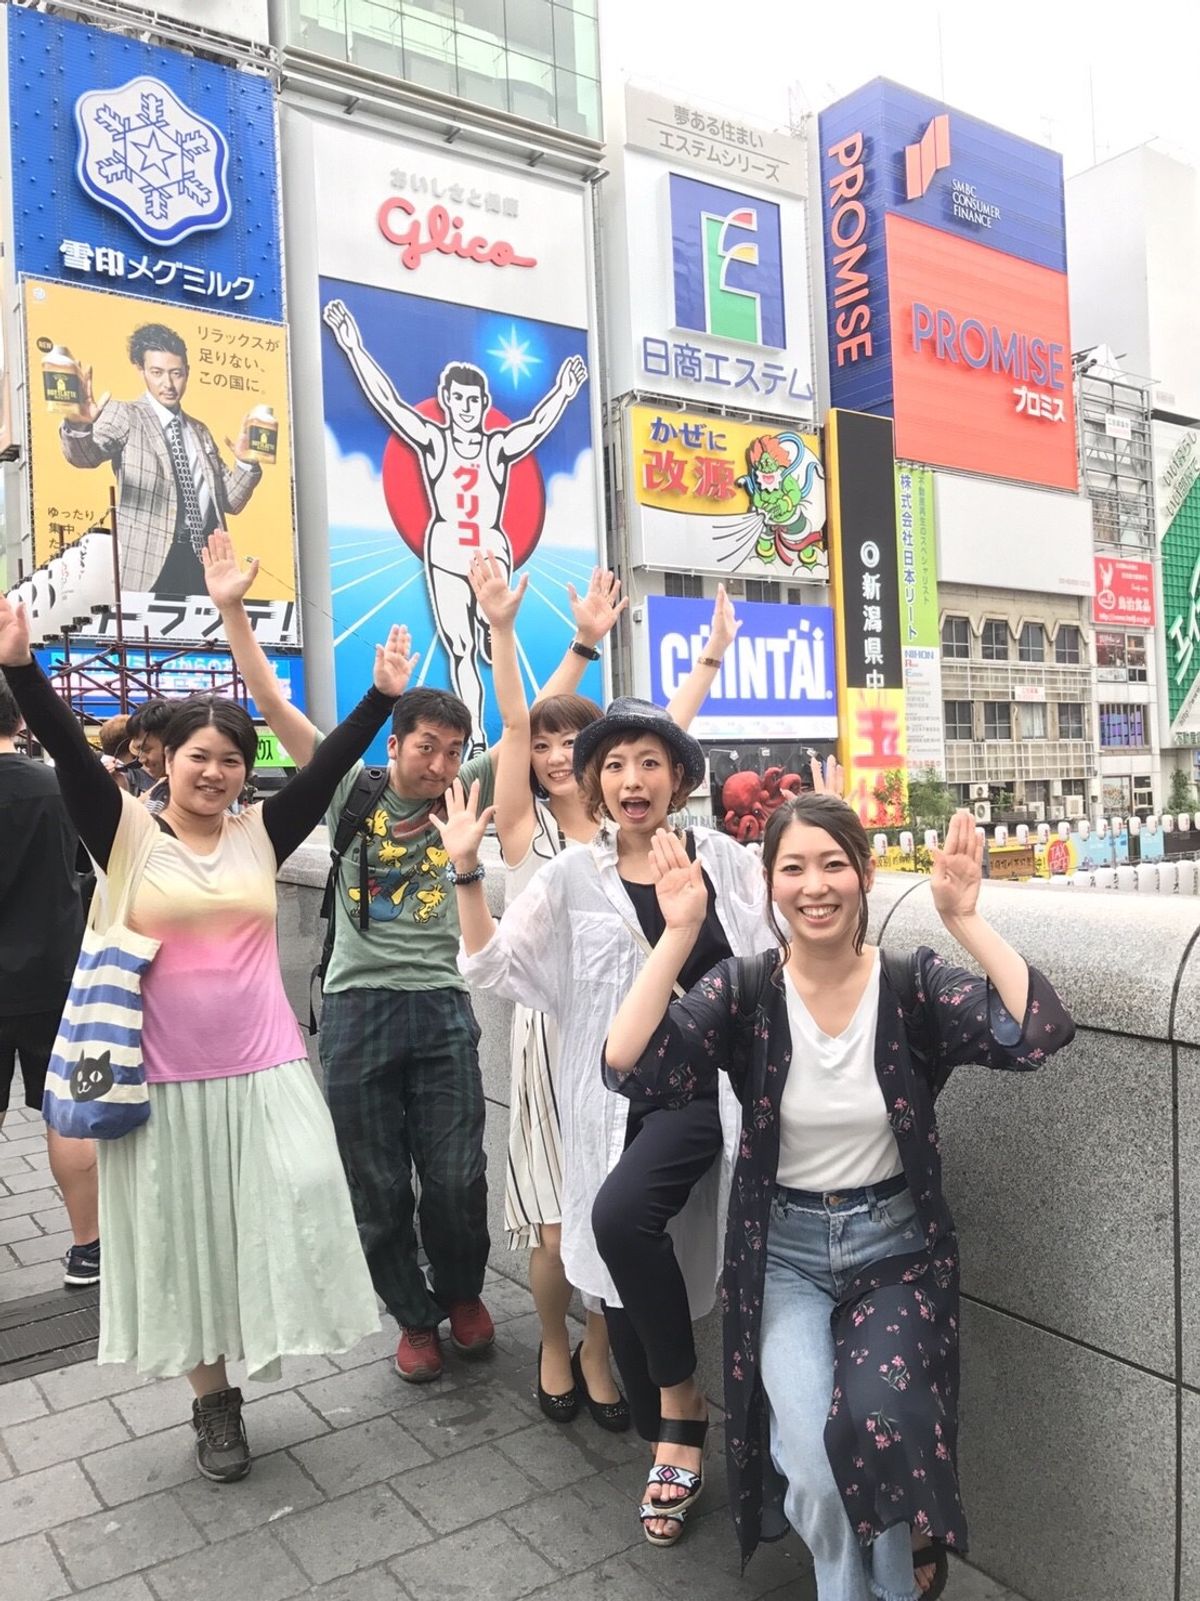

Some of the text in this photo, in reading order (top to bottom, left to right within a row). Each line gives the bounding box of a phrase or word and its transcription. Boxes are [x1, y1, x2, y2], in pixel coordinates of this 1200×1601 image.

[673, 104, 764, 149] 夢ある住まい
[659, 130, 780, 182] エステムシリーズ
[952, 178, 977, 198] SMBC
[952, 191, 1001, 220] CONSUMER
[377, 197, 537, 270] Glico
[953, 204, 992, 228] FINANCE
[59, 239, 255, 300] 雪印メグミルク
[828, 130, 873, 367] PROMISE
[198, 326, 279, 352] リラックスが
[199, 347, 265, 373] 足りない、
[912, 302, 1065, 390] PROMISE
[200, 371, 265, 394] この国に。
[643, 336, 814, 401] 日商エステム
[1013, 386, 1066, 422] プロミス
[651, 416, 727, 451] かぜに
[643, 449, 737, 501] 改源
[47, 507, 95, 521] ゆったり
[452, 463, 480, 547] グリコ
[900, 474, 918, 641] 株式会社日本リート
